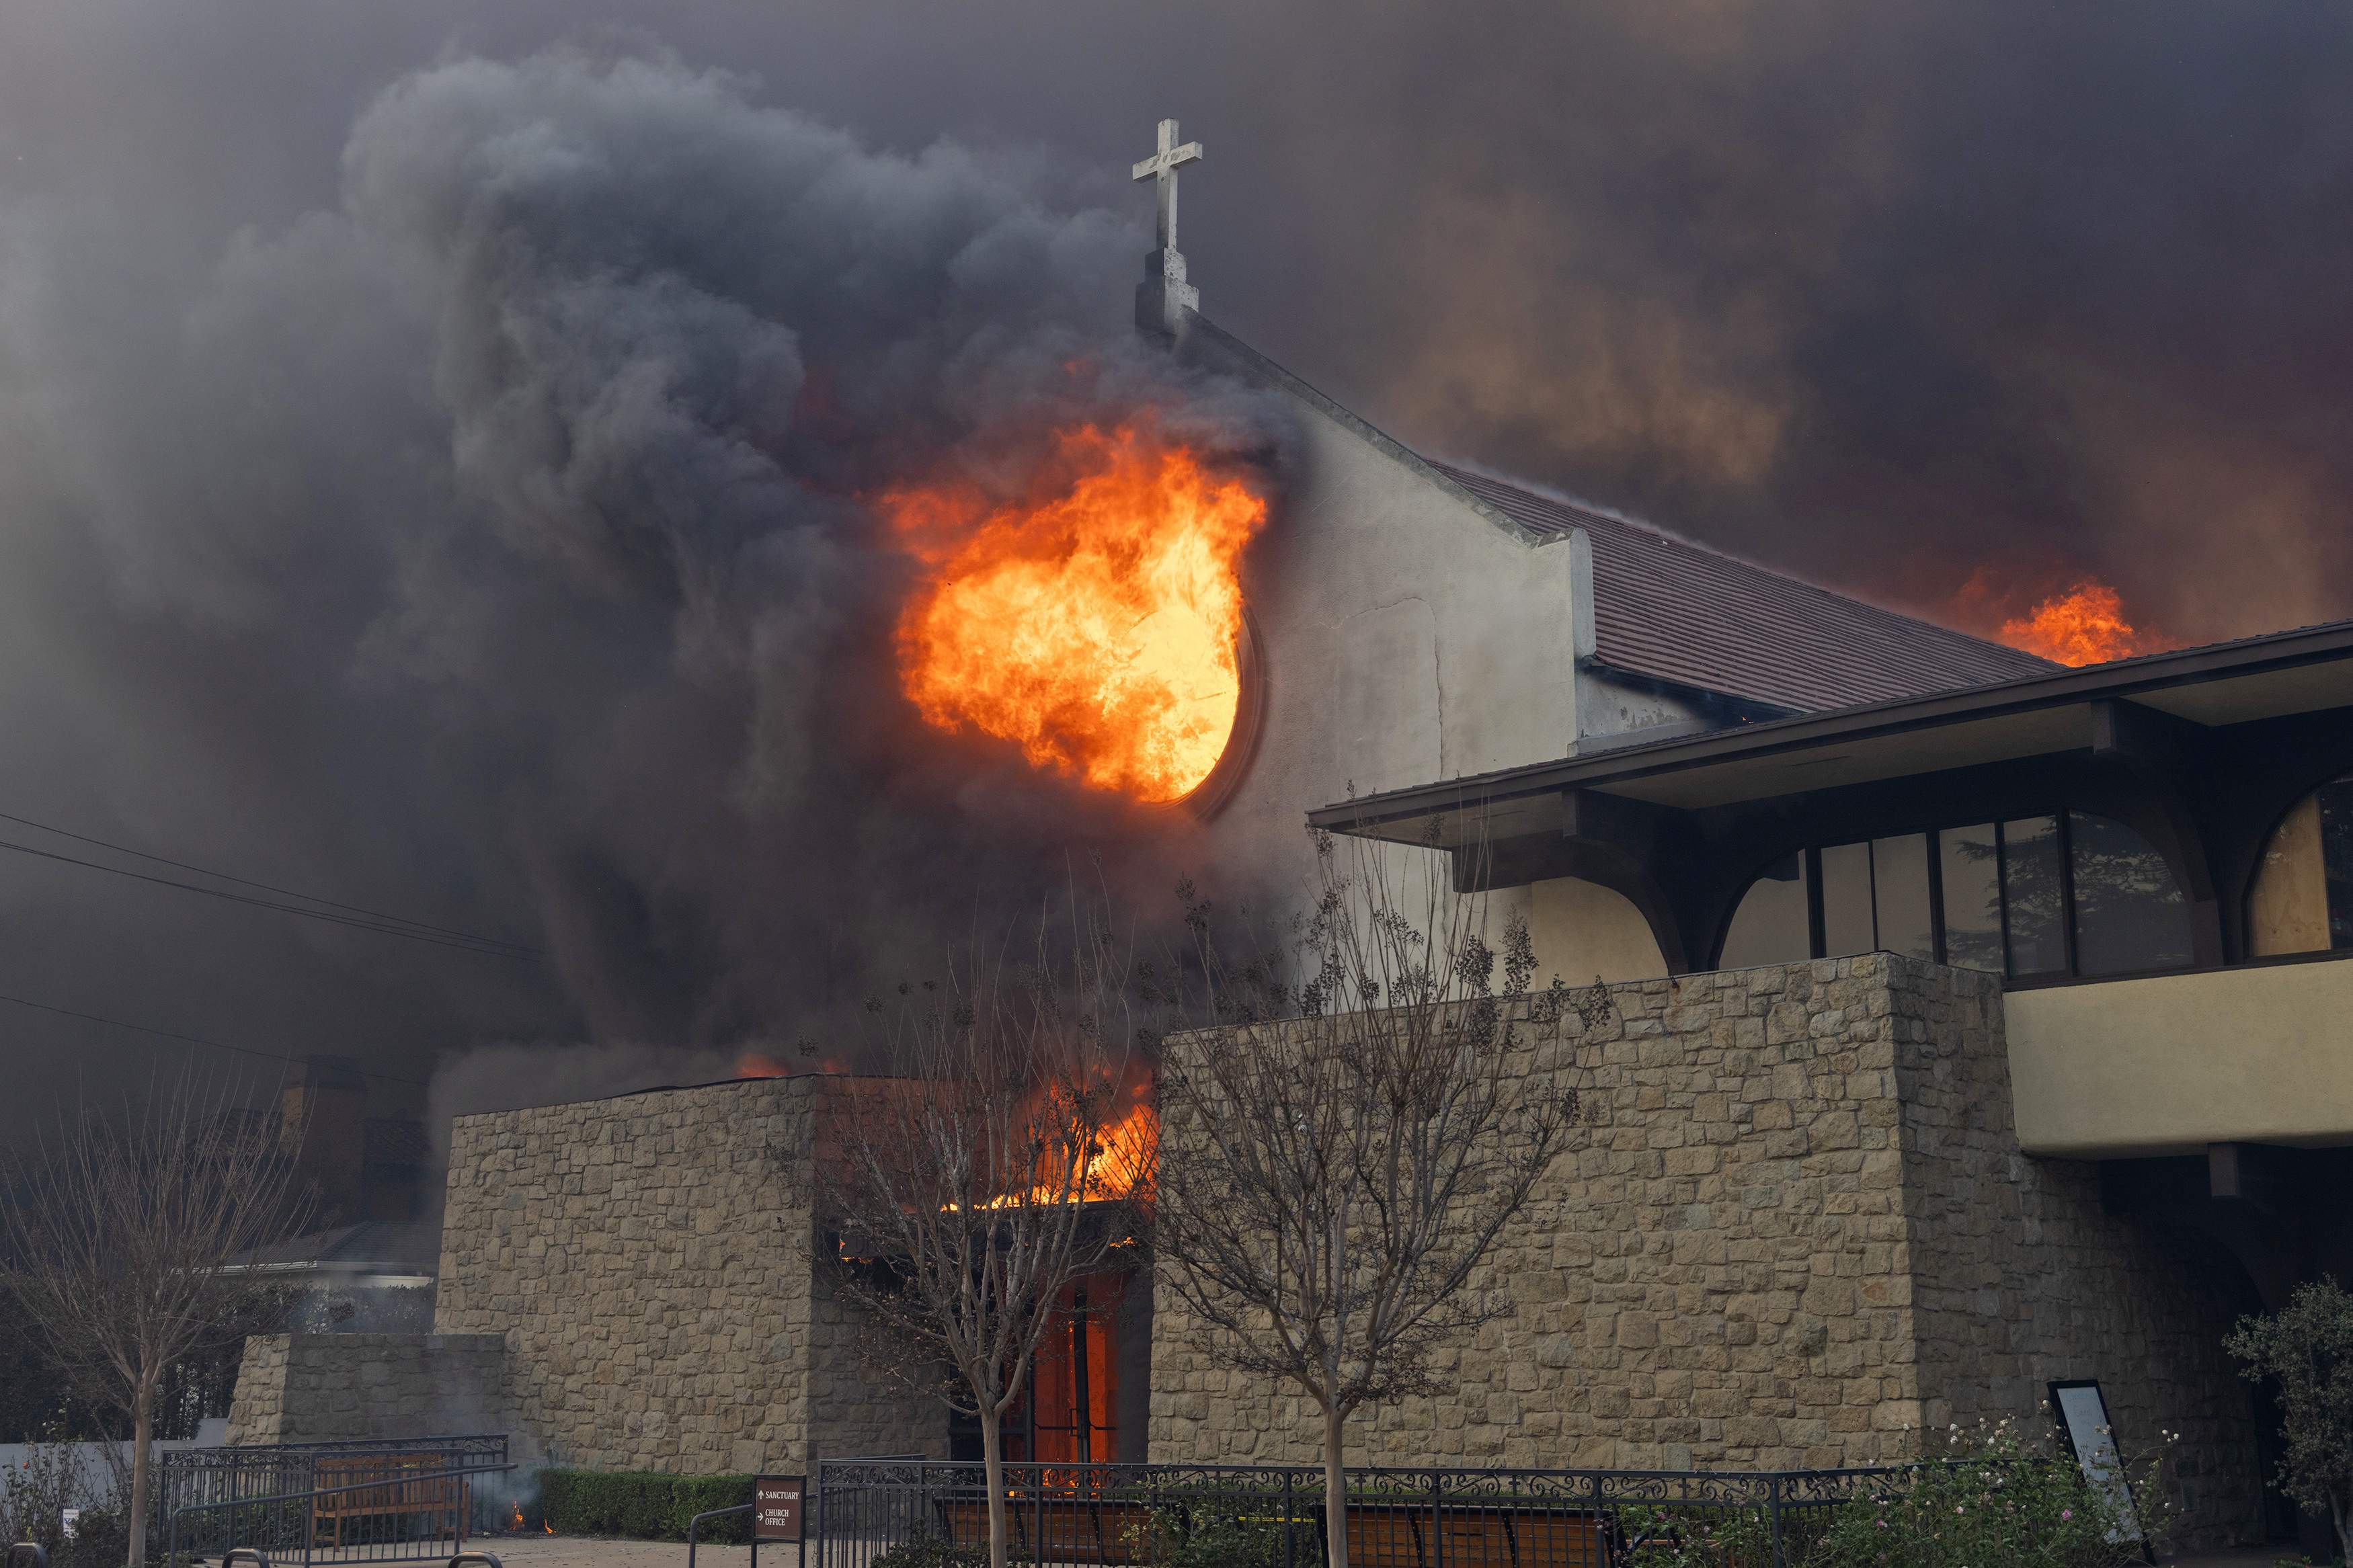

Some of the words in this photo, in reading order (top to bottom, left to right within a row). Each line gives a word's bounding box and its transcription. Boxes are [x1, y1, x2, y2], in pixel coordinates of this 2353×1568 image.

[766, 1491, 799, 1499] SANCTUARY
[765, 1509, 789, 1517] CHURCH
[765, 1518, 785, 1526] OFFICE
